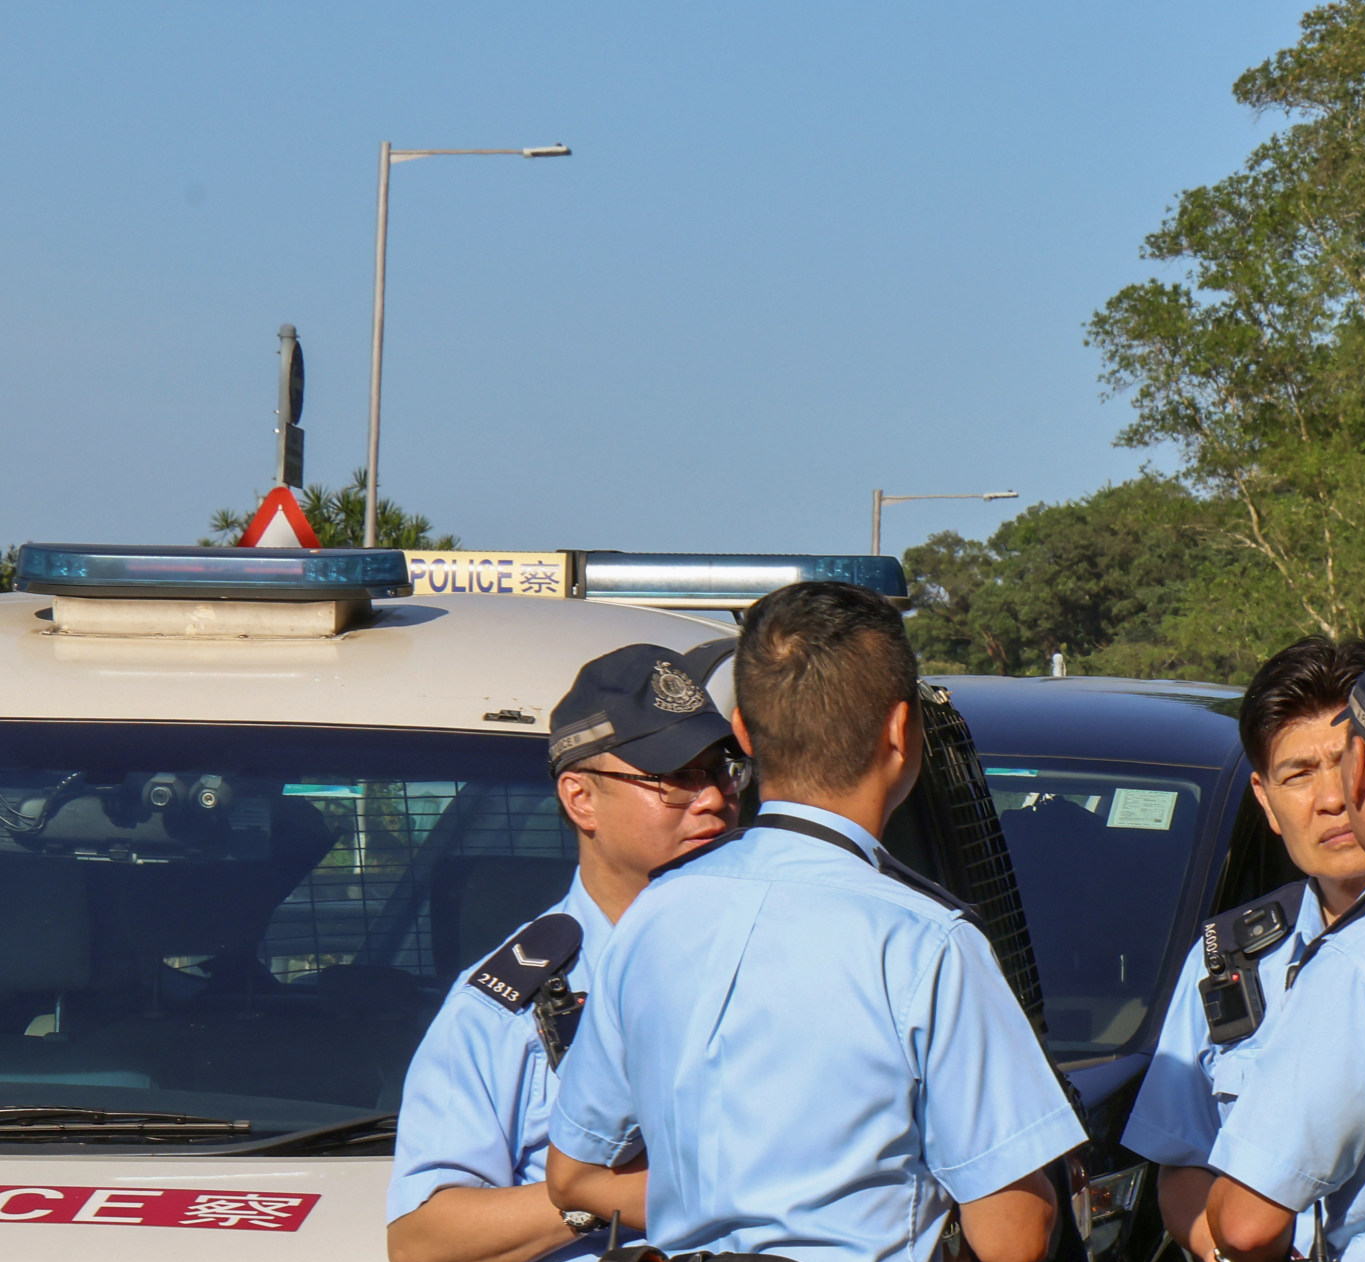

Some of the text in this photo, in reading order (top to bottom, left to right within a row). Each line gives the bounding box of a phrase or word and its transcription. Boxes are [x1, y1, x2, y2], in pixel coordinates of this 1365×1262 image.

[411, 558, 560, 593] POLICE 察
[478, 973, 520, 1002] 21813
[179, 1193, 304, 1229] 察
